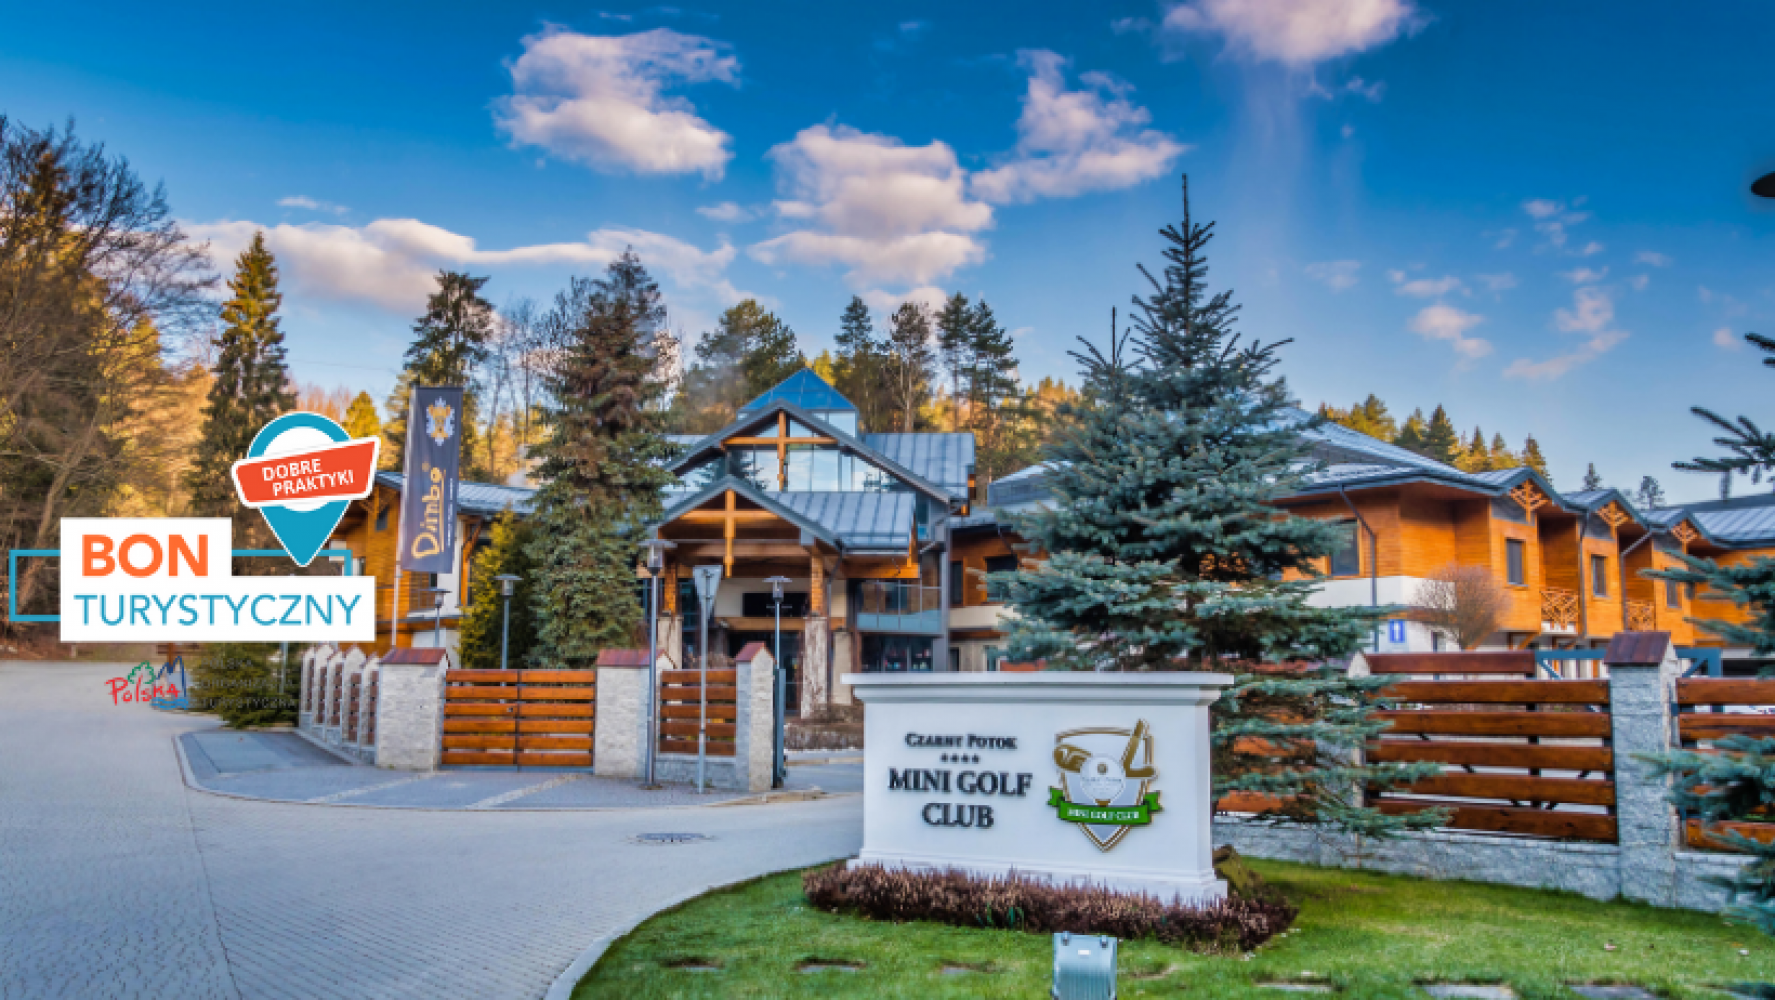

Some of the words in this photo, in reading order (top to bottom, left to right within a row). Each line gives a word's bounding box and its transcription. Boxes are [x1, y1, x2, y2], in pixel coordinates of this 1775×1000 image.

[411, 467, 440, 559] Dimbo
[967, 734, 1017, 750] POTOK
[888, 767, 952, 793] MINI
[957, 770, 1033, 797] GOLF
[922, 802, 994, 829] CLUB
